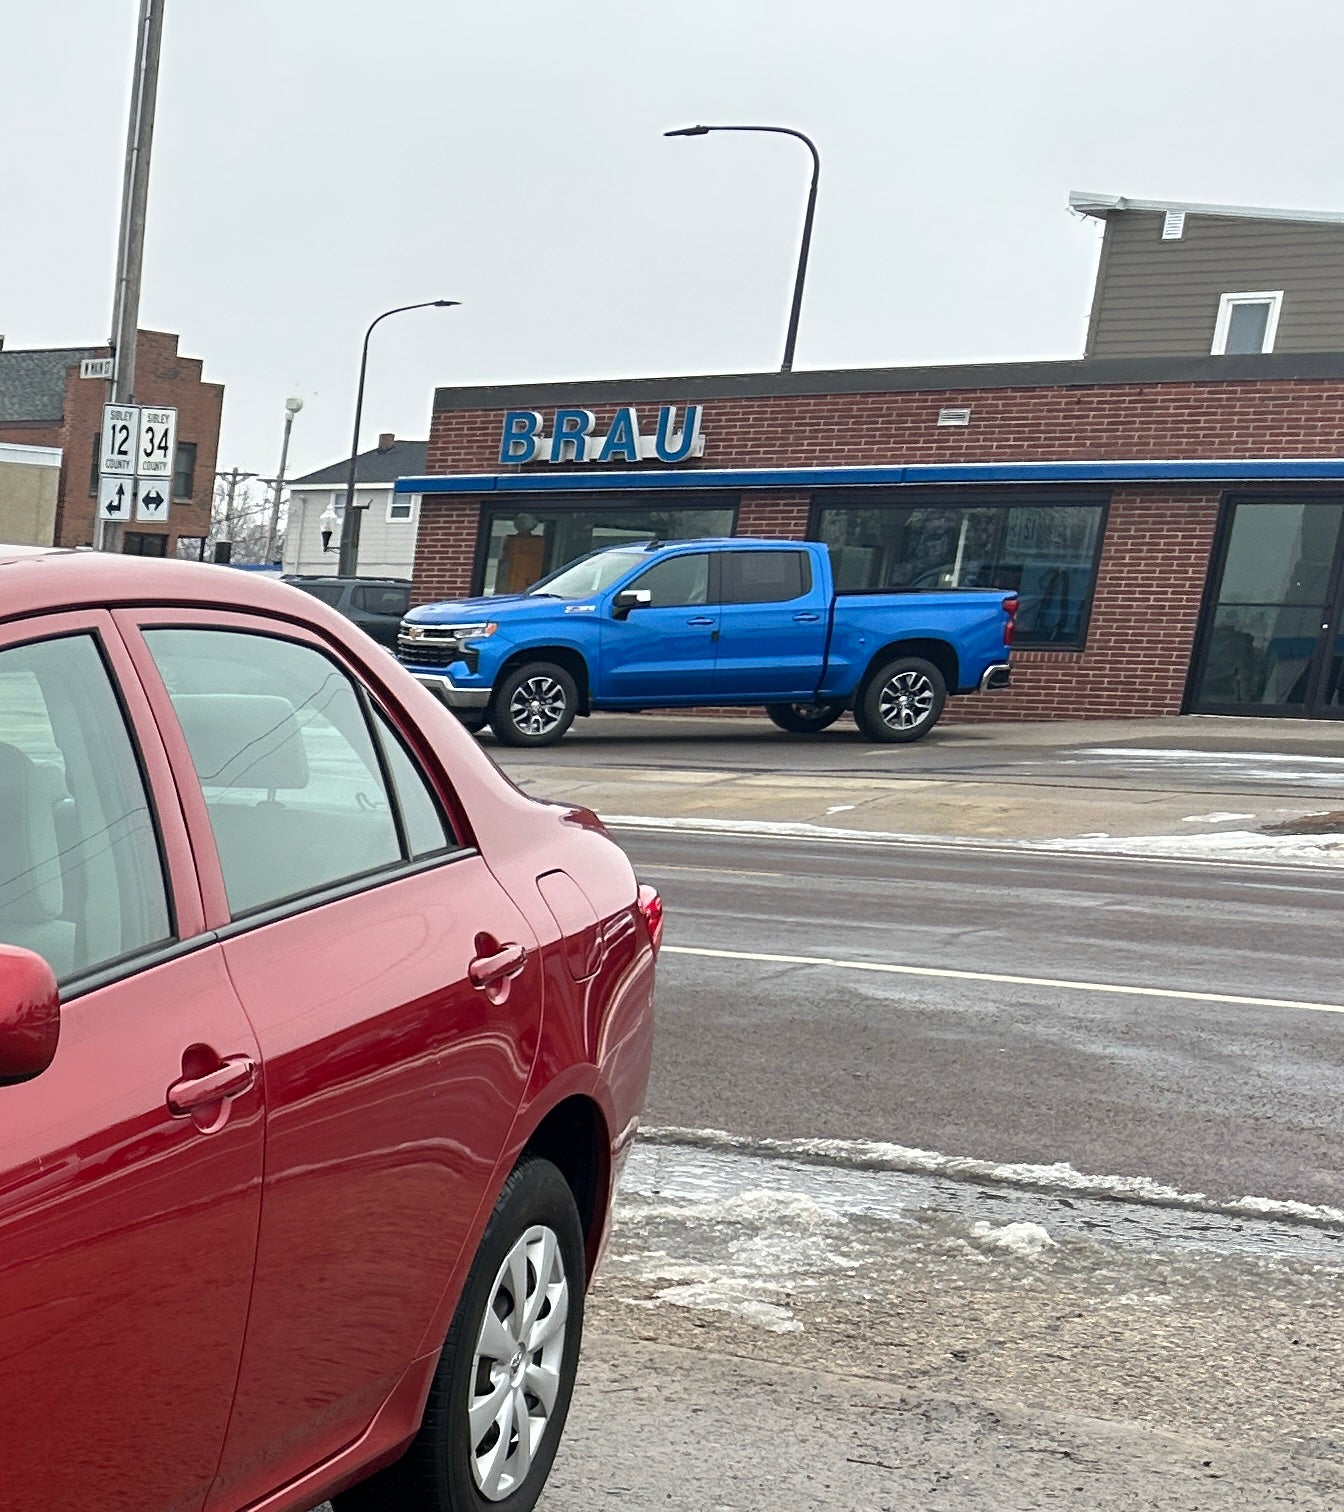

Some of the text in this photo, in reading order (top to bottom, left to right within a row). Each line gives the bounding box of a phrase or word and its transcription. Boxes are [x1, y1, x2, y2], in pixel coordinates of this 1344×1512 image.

[110, 410, 133, 421] SIBLEY
[147, 413, 170, 424] SIBLEY
[111, 424, 130, 455] 12
[499, 405, 700, 464] BRAU
[143, 427, 169, 458] 34
[105, 459, 131, 470] COUNTY
[143, 461, 167, 471] COUNTY
